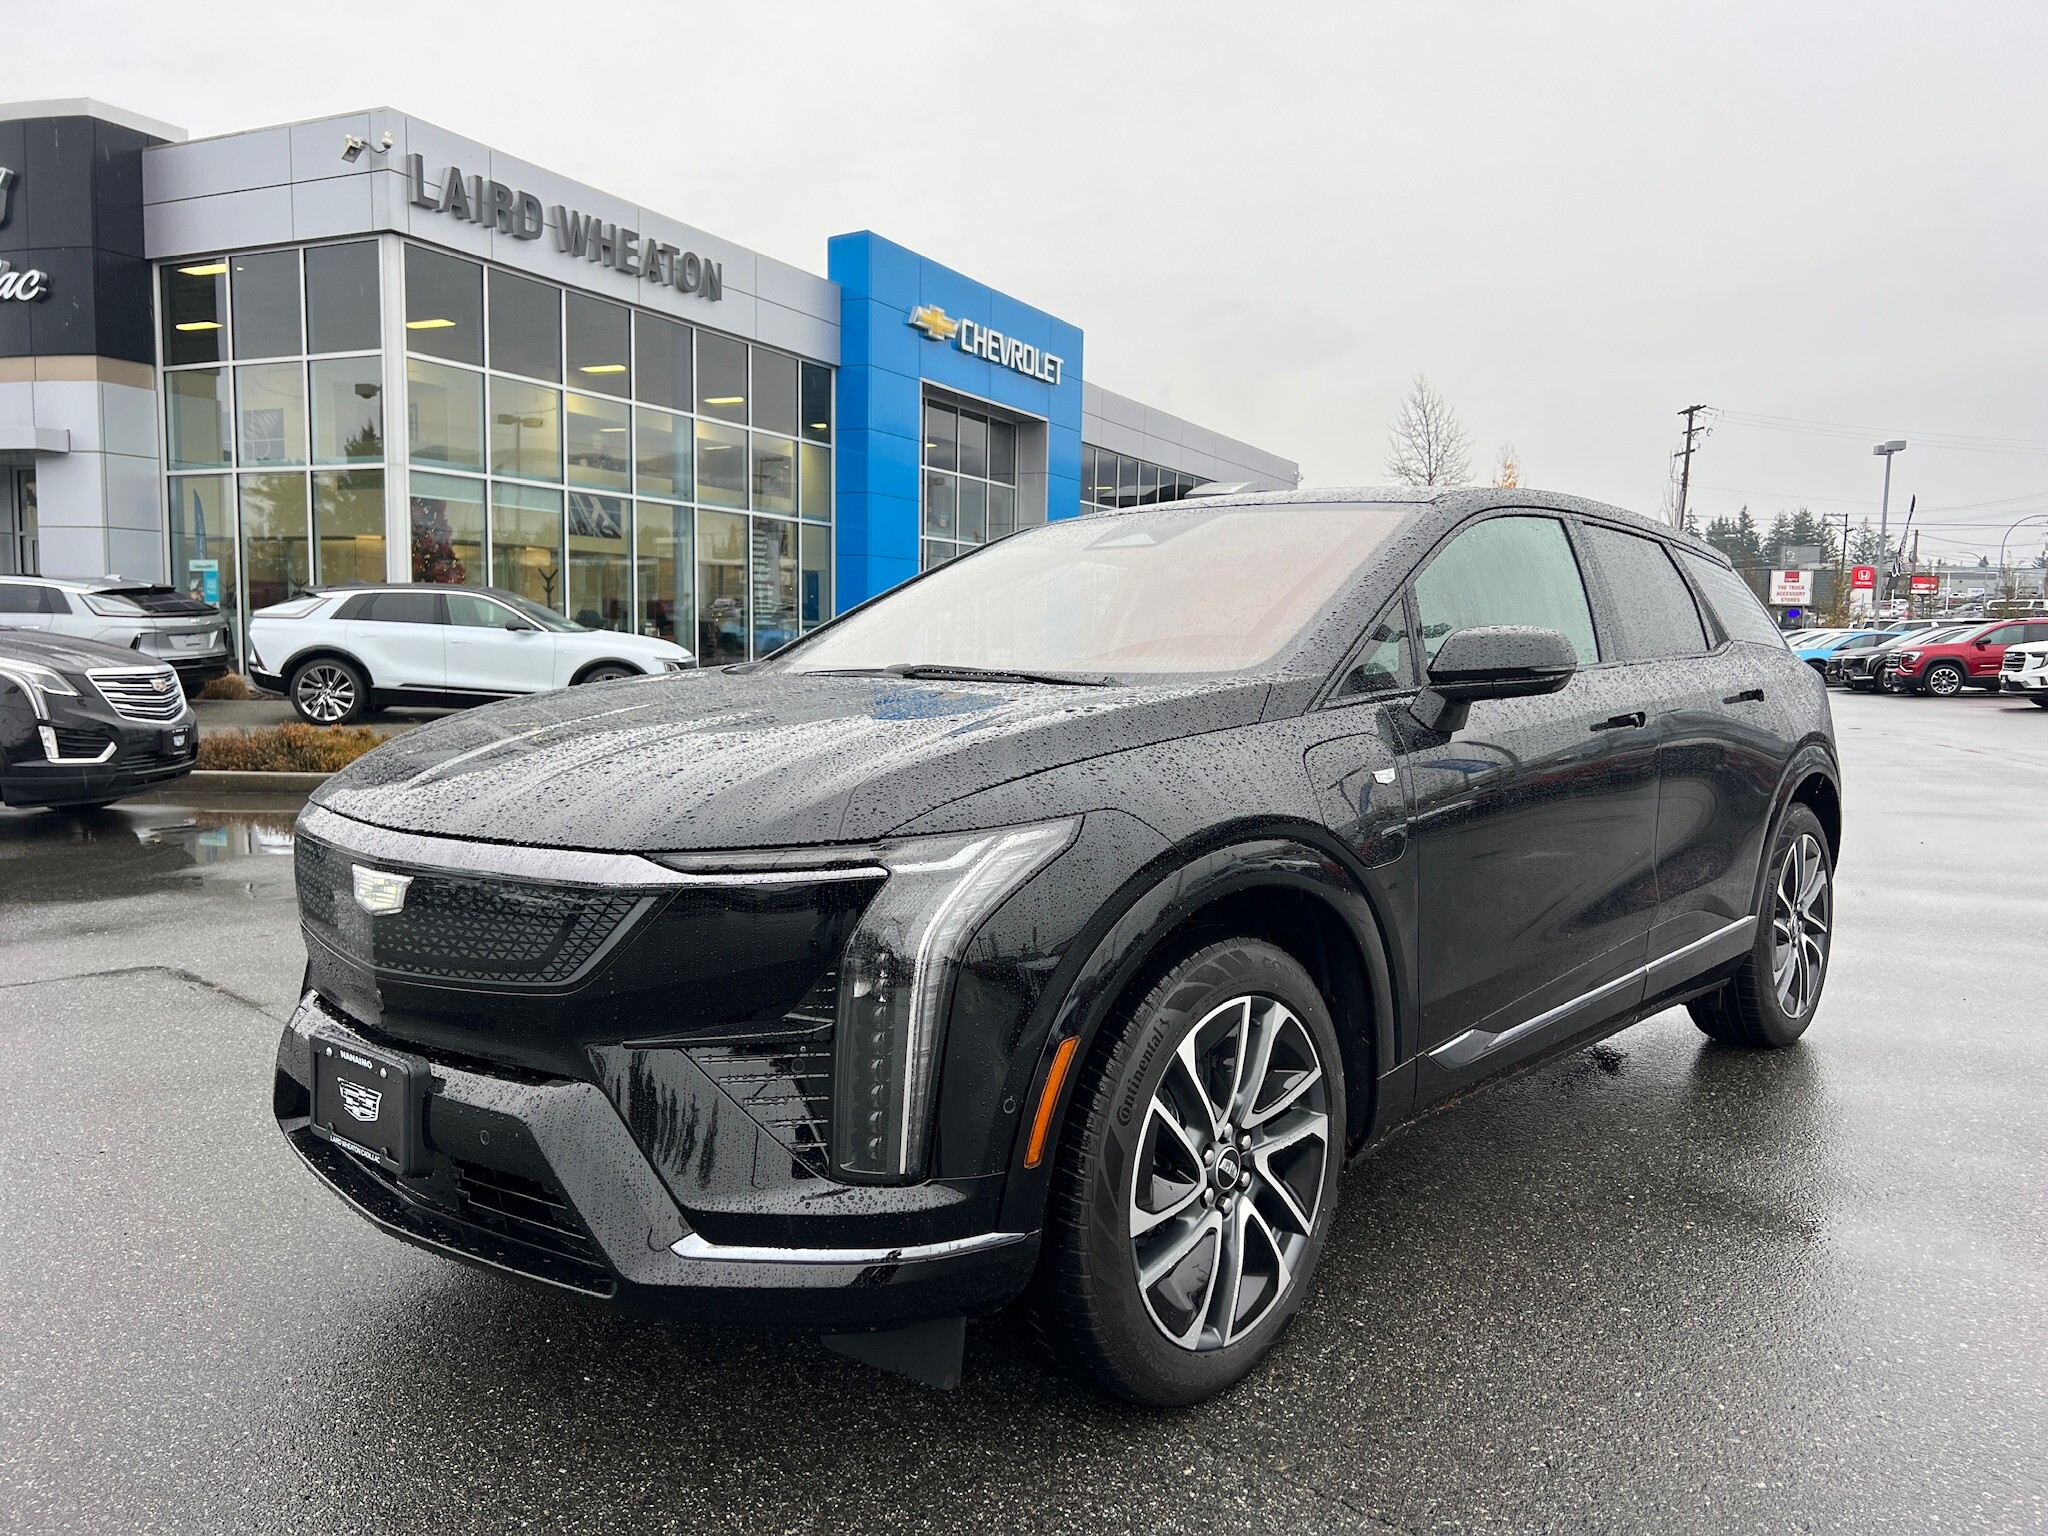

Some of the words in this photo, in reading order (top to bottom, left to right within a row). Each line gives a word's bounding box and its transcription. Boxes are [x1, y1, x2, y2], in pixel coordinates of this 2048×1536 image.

[408, 153, 543, 240] LAIRD
[552, 205, 722, 300] WHEATON
[960, 318, 1064, 385] CHEVROLET
[340, 1049, 373, 1069] NANAIMO
[1117, 1026, 1165, 1126] Continental
